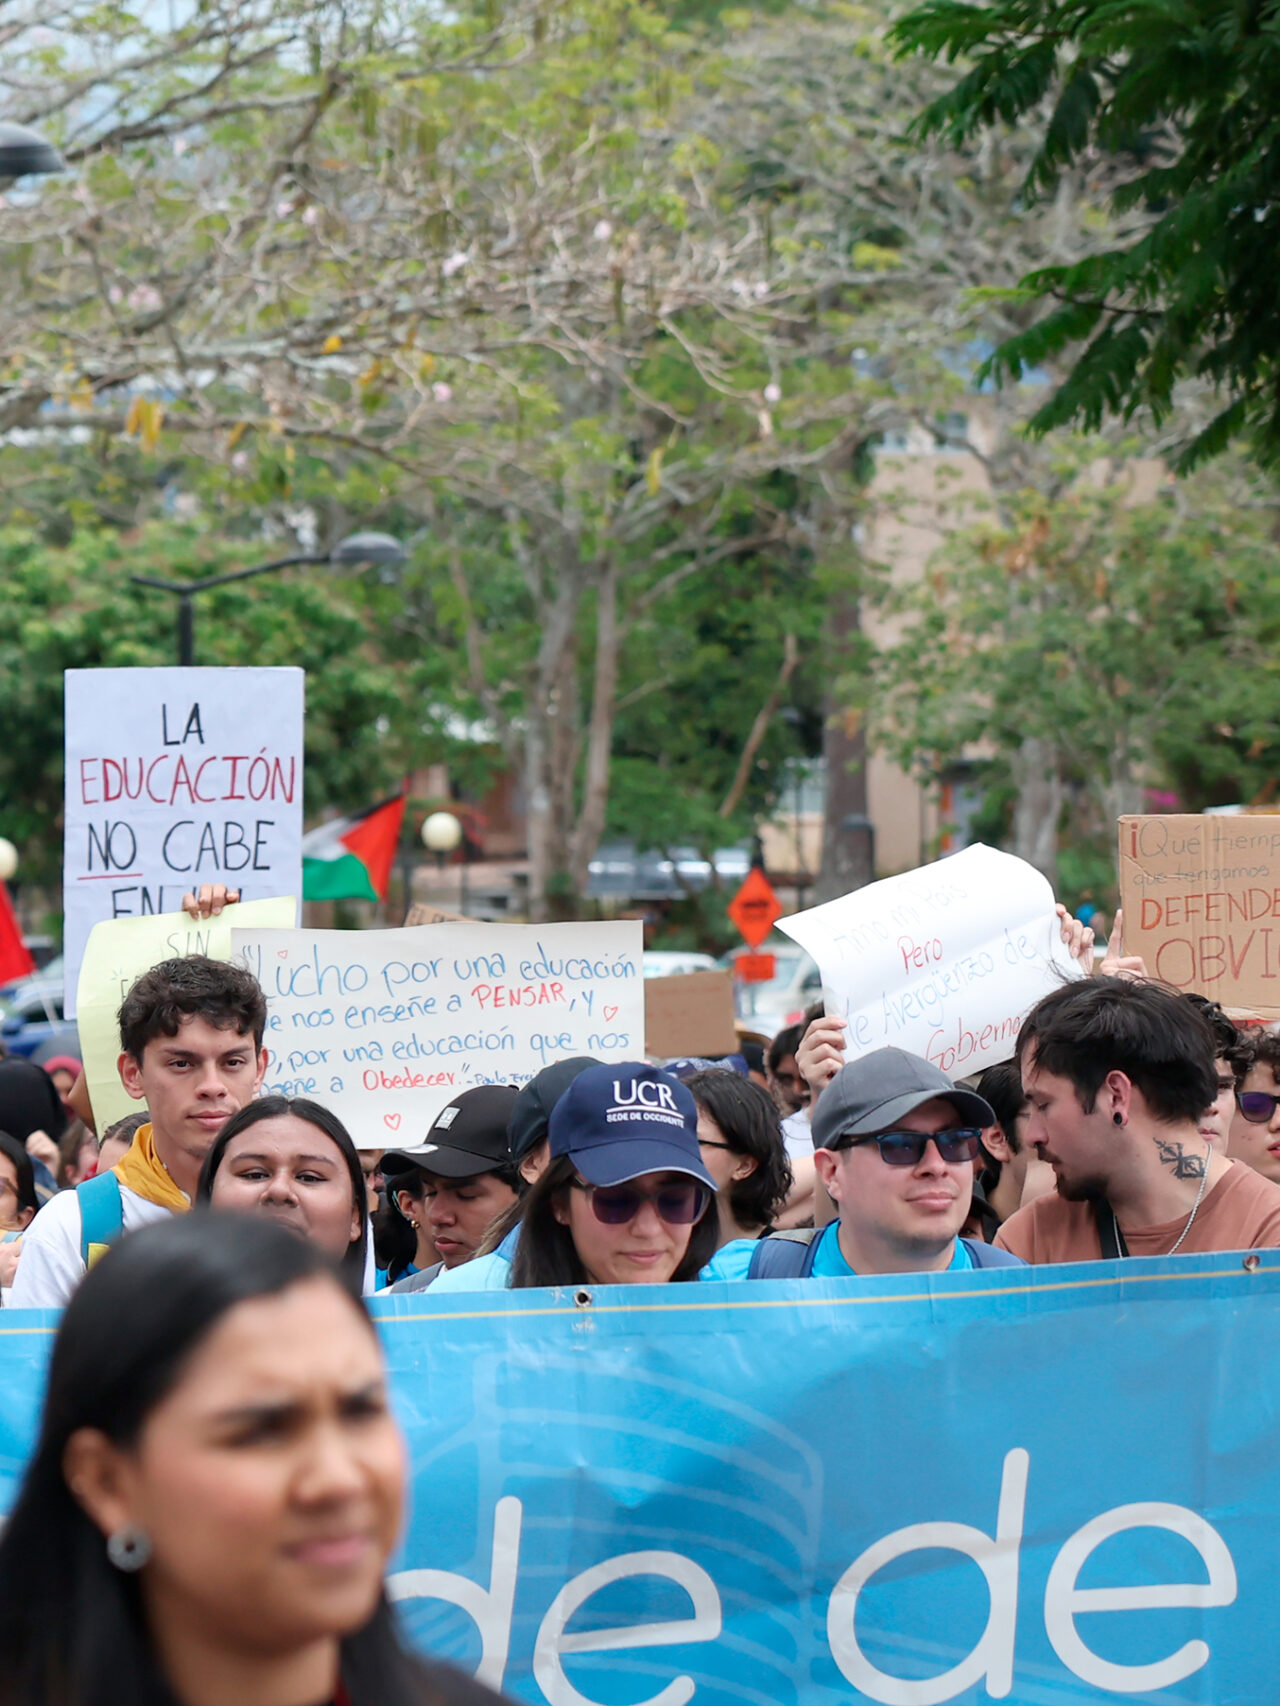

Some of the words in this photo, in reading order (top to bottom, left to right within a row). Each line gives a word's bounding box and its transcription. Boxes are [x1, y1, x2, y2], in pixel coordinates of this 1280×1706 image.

[162, 702, 205, 746] LA
[80, 747, 295, 805] EDUCACIÓN
[87, 820, 138, 872] NO
[162, 820, 275, 873] CABE
[1174, 862, 1270, 891] tengamos
[896, 935, 943, 975] Pero
[1004, 927, 1037, 966] de
[1155, 928, 1280, 988] OBVI
[380, 957, 444, 998] por
[453, 952, 507, 981] una
[519, 942, 636, 981] educación
[291, 1007, 335, 1028] nos
[344, 996, 438, 1029] enseñe
[446, 994, 463, 1012] a
[287, 1048, 331, 1074] por
[343, 1040, 384, 1063] una
[391, 1025, 516, 1061] educación
[529, 1032, 579, 1066] que
[587, 1031, 631, 1050] nos
[329, 1076, 345, 1093] a
[612, 1078, 678, 1111] UCR
[606, 1112, 629, 1123] SEDE
[630, 1112, 642, 1121] DE
[642, 1112, 685, 1129] OCCIDENTE
[826, 1447, 1238, 1706] de
